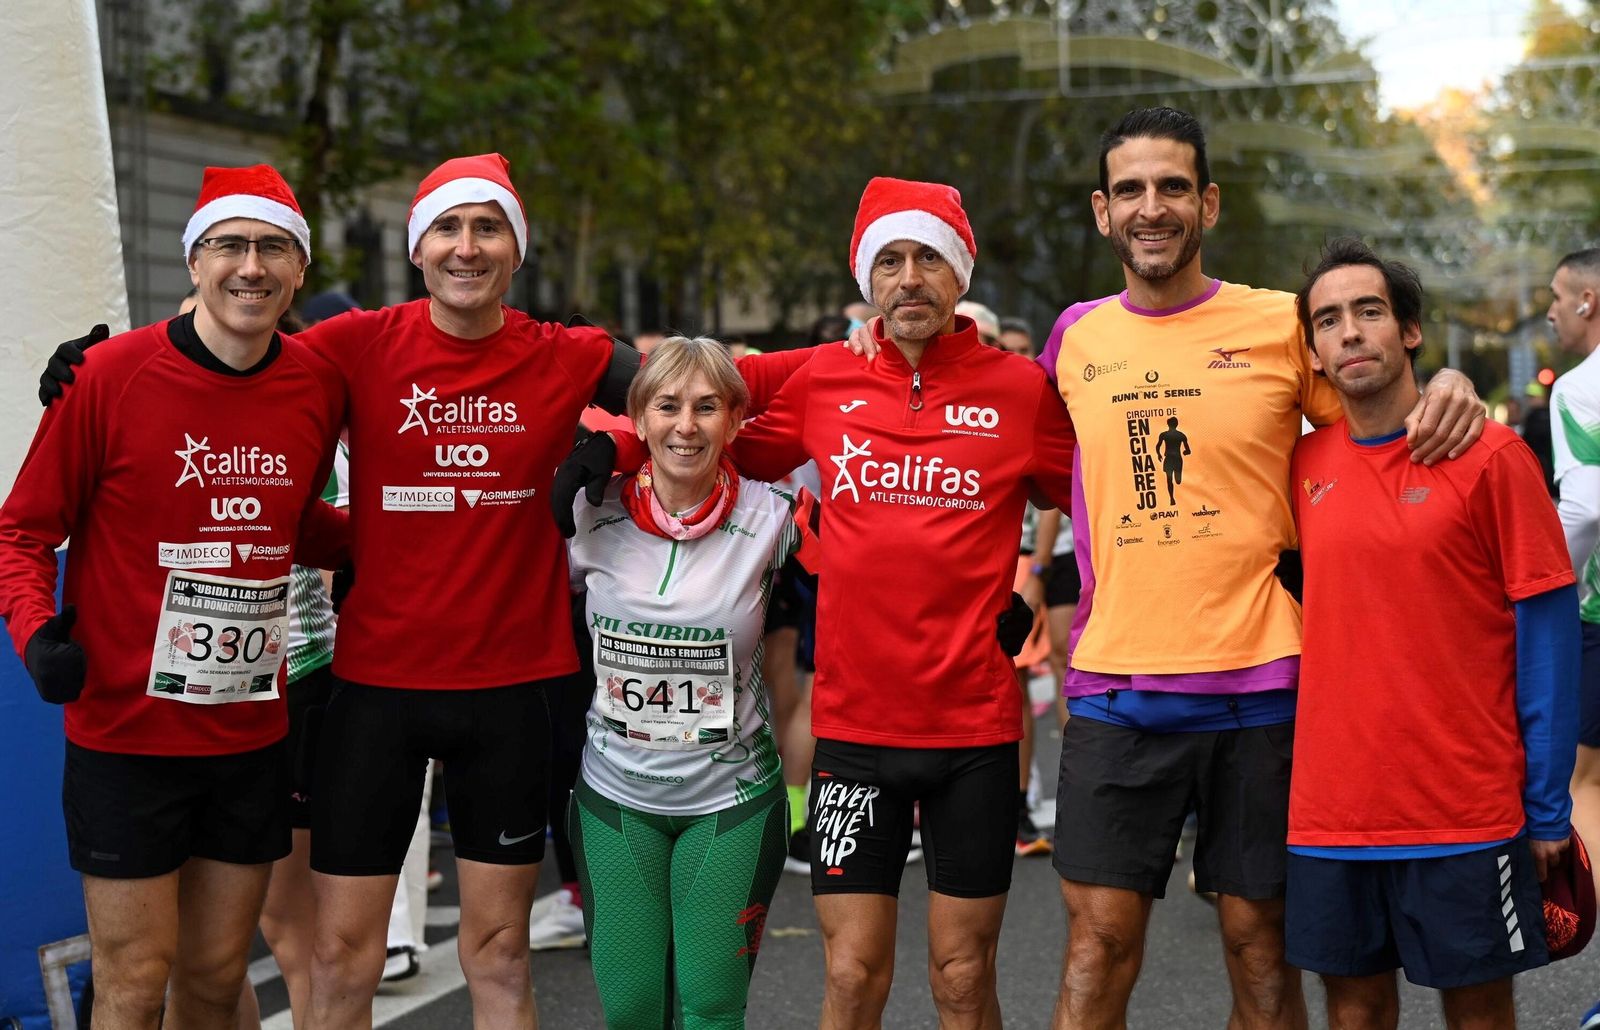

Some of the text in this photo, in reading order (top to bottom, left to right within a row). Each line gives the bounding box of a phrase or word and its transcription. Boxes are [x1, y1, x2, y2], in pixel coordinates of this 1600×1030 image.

[1097, 360, 1127, 375] BELIEVE
[1164, 388, 1201, 398] SERIES
[429, 395, 518, 423] califas
[945, 404, 1000, 429] UCO
[1126, 407, 1177, 420] CIRCUITO DE
[1128, 418, 1150, 437] EN
[435, 444, 490, 468] UCO
[1129, 437, 1147, 456] CI
[203, 446, 288, 475] califas
[1132, 454, 1156, 474] NA
[471, 470, 501, 478] CÓRDOBA
[860, 454, 981, 496] califas
[1134, 473, 1156, 492] RE
[400, 491, 454, 503] IMDECO
[481, 488, 535, 501] AGRIMENSUR
[1137, 490, 1157, 510] JO
[210, 497, 262, 521] UCO
[1158, 510, 1179, 519] RAVI
[199, 525, 237, 533] UNIVERSIDAD
[244, 524, 272, 532] CÓRDOBA
[177, 546, 230, 560] IMDECO
[230, 588, 238, 599] A
[239, 589, 257, 600] LAS
[172, 595, 191, 607] POR
[191, 597, 202, 609] LA
[203, 600, 248, 614] DONACIÓN
[249, 604, 260, 614] DE
[626, 621, 726, 642] SUBIDA
[187, 623, 266, 664] 330
[601, 636, 721, 658] XII SUBIDA A LAS ERMITAS
[600, 650, 616, 662] POR
[616, 654, 628, 665] LA
[628, 656, 671, 669] DONACIÓN
[672, 660, 684, 669] DE
[621, 678, 701, 714] 641
[814, 781, 880, 827] NEVER
[816, 806, 866, 840] GIVE
[820, 836, 857, 867] UP
